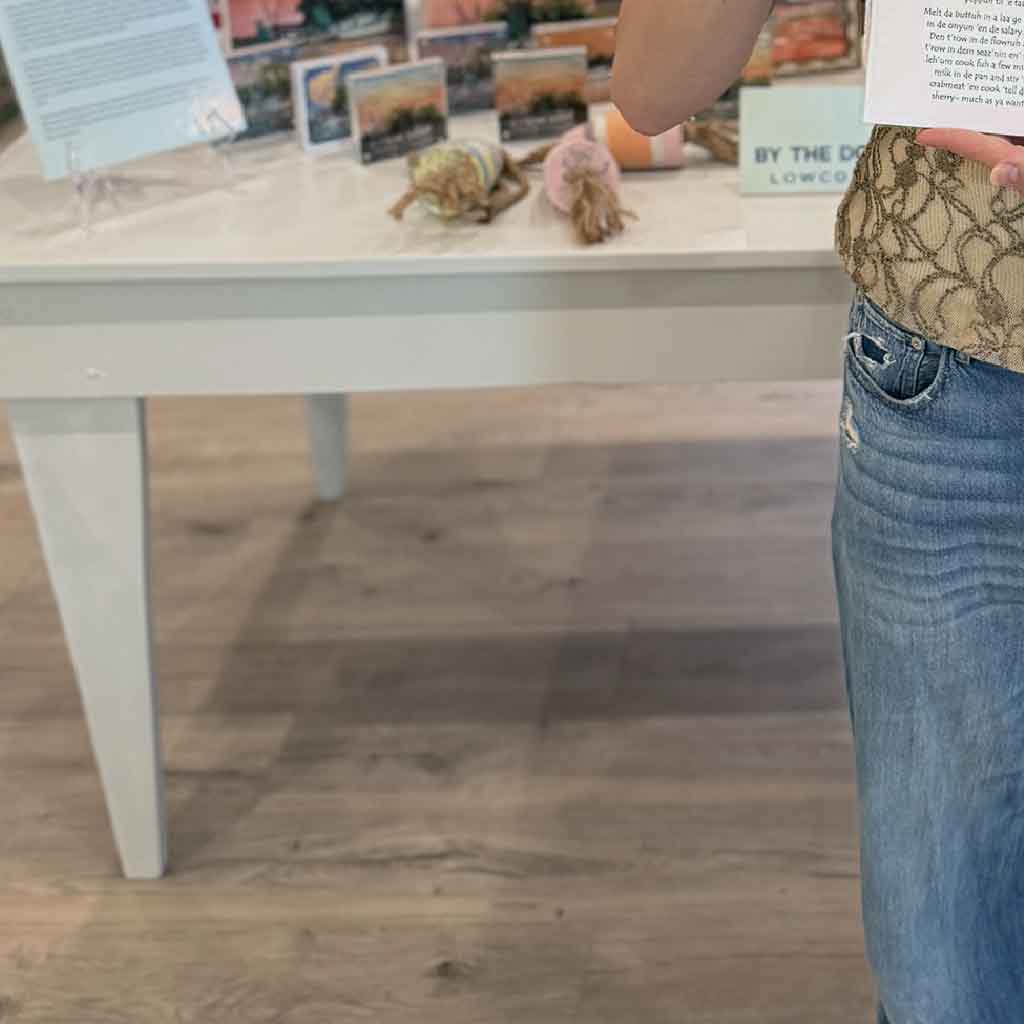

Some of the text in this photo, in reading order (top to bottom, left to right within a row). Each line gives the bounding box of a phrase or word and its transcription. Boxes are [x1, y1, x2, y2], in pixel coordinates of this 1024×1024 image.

[923, 7, 942, 16] Melt
[929, 31, 945, 40] Den
[979, 36, 989, 44] de
[954, 57, 975, 67] cook
[997, 61, 1011, 70] few
[962, 70, 973, 78] de
[974, 73, 989, 82] pan
[990, 72, 1004, 81] and
[980, 83, 1001, 92] cook
[961, 93, 983, 103] much
[754, 145, 782, 163] BY
[790, 145, 831, 163] THE
